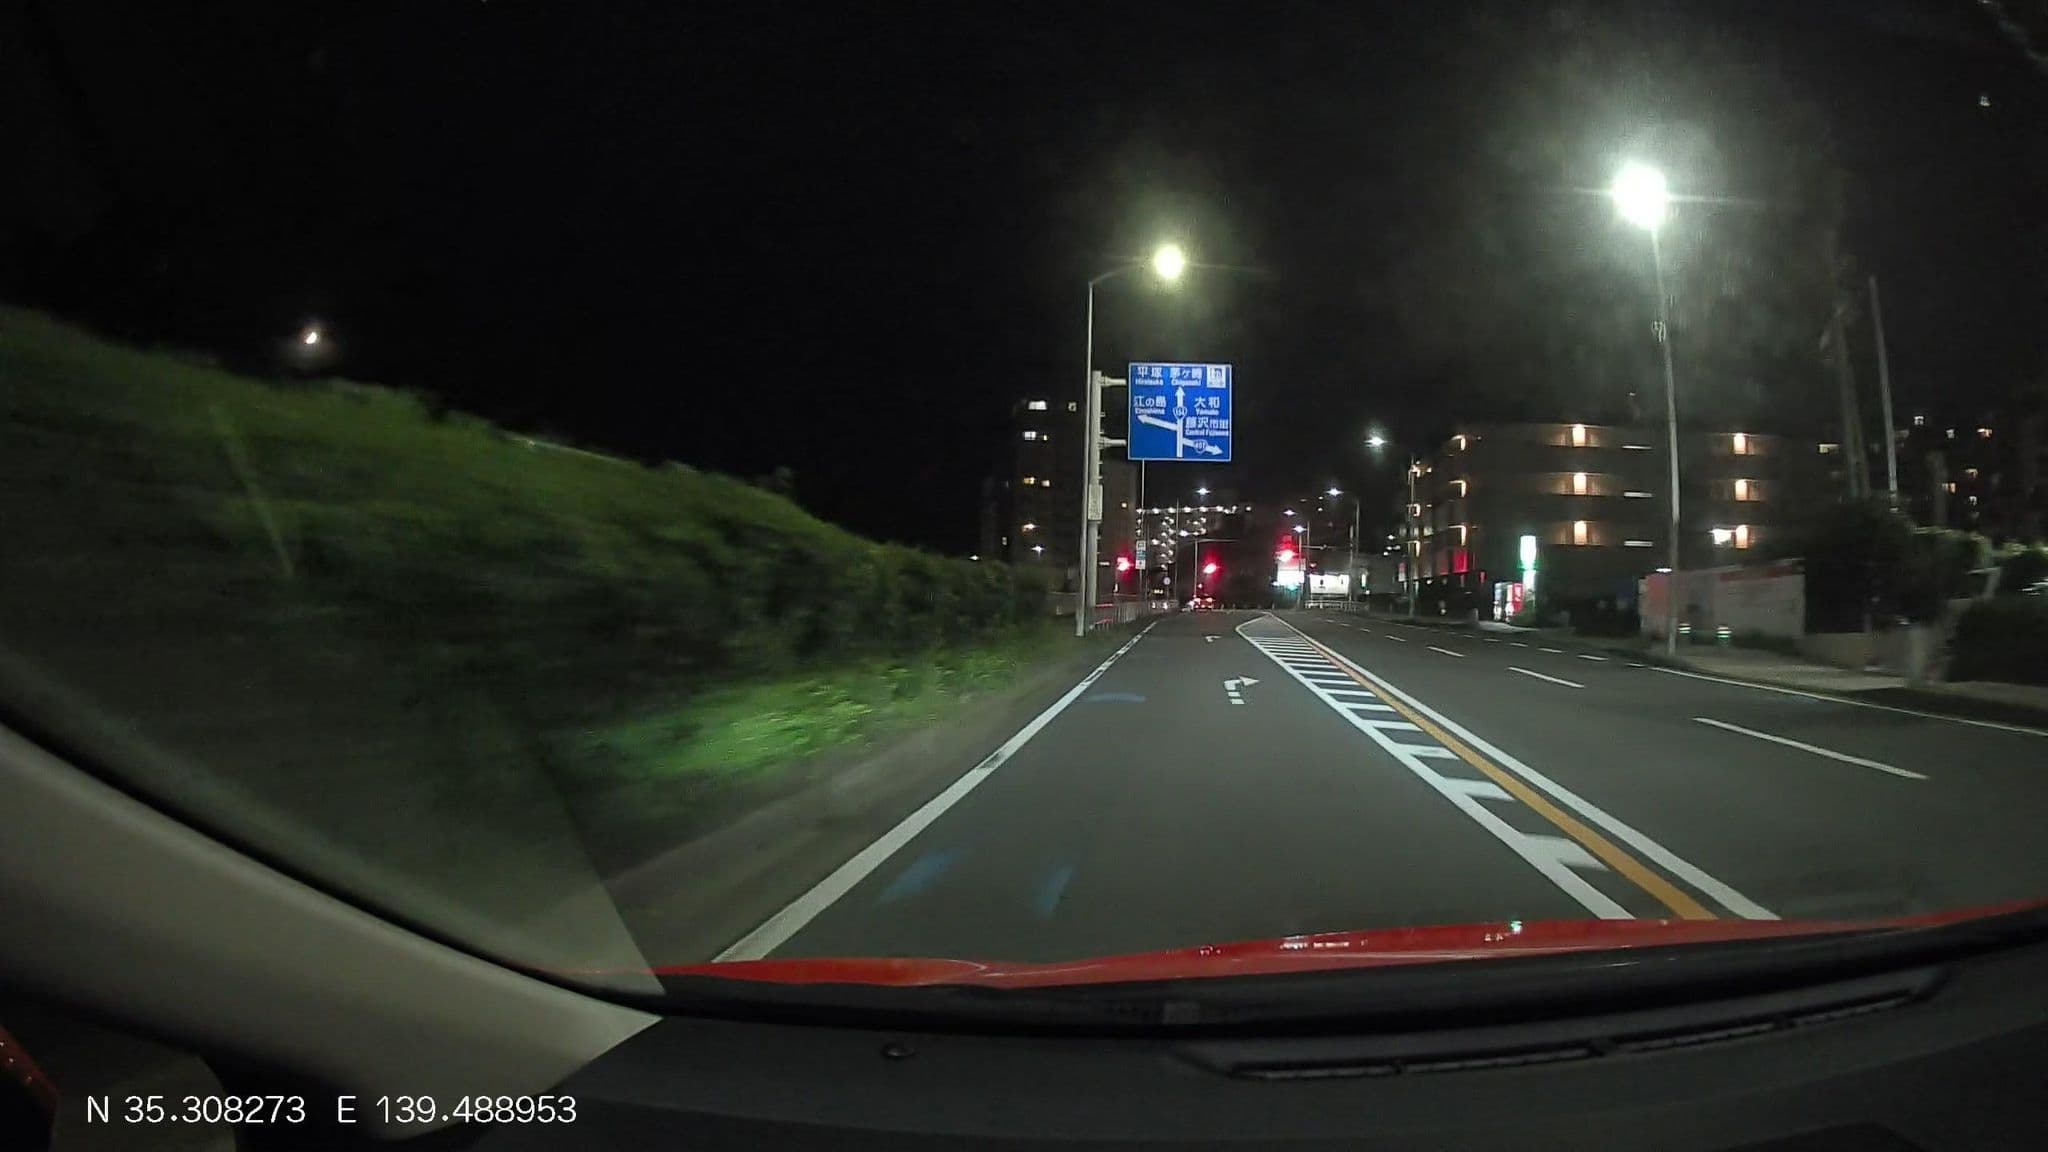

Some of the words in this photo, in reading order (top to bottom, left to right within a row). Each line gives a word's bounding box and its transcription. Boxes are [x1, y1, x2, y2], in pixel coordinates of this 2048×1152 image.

[1133, 396, 1166, 408] 江の島
[1194, 397, 1220, 408] 大和
